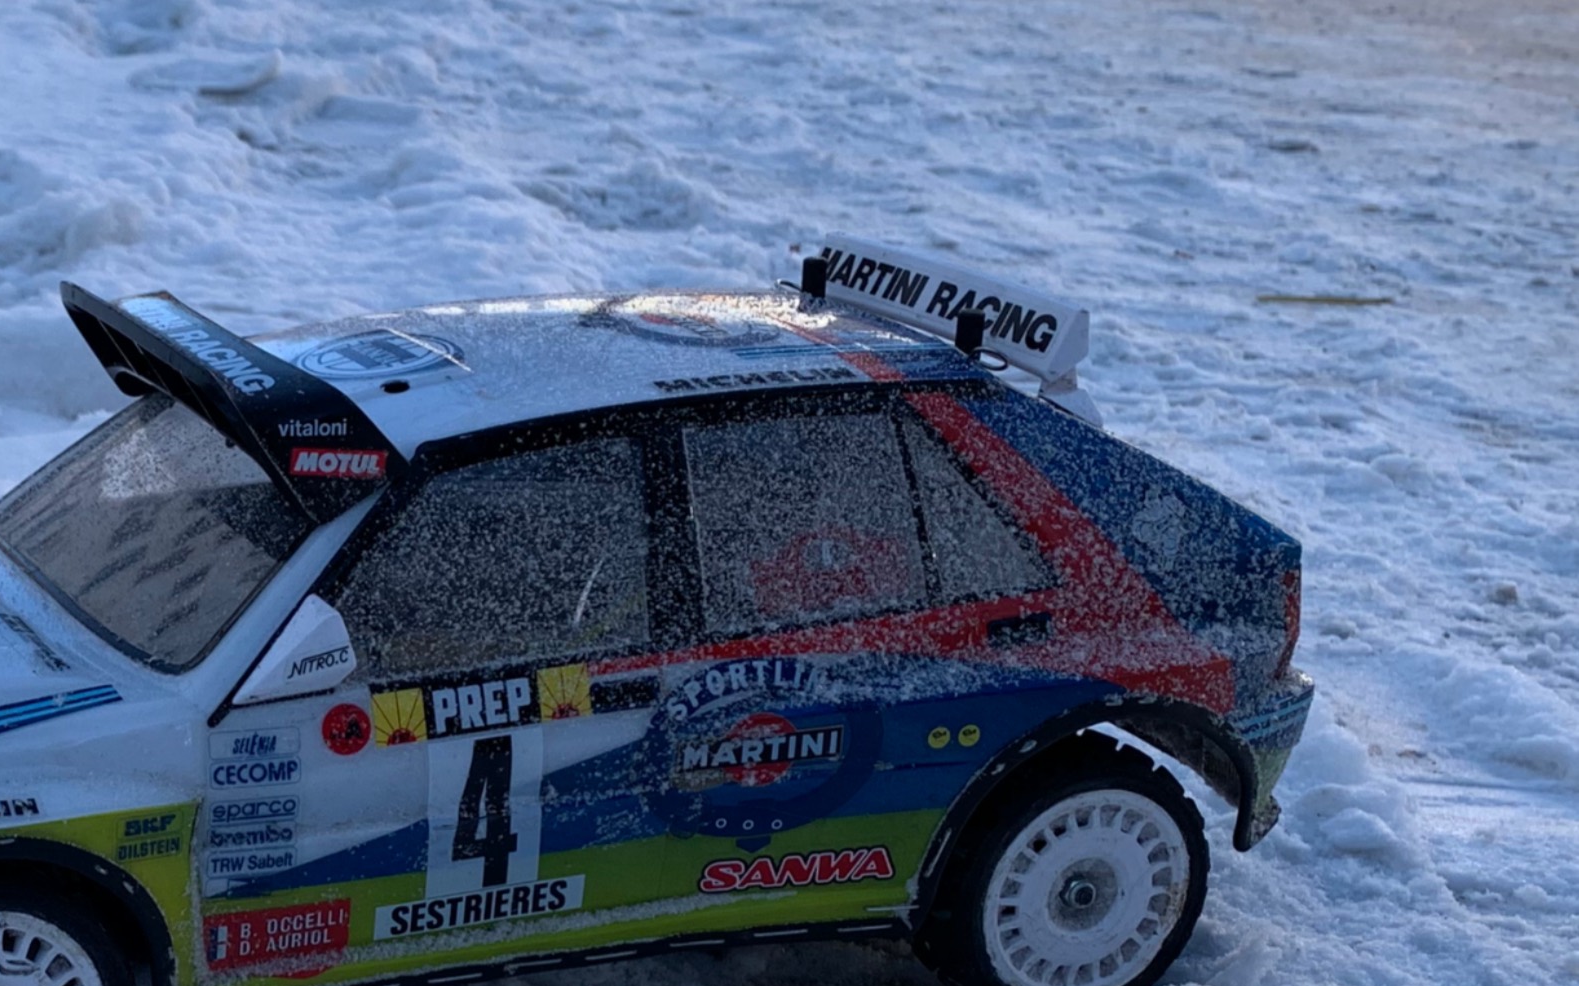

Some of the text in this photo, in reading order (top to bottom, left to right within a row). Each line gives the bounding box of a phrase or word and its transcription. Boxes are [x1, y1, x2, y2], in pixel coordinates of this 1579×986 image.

[821, 247, 1057, 352] MARTINI RACING
[178, 327, 276, 396] RACING
[654, 366, 858, 393] MICHELIN
[278, 418, 347, 437] vitaloni
[293, 450, 384, 475] MOTUL
[432, 677, 531, 734] PREP
[682, 728, 840, 771] MARTINI
[213, 759, 298, 786] CECOMP
[211, 798, 297, 823] sparco
[451, 735, 518, 888] 4
[210, 825, 294, 847] brembo
[211, 852, 294, 874] TRW Sabelt
[699, 847, 894, 893] SANWA
[389, 879, 568, 936] SESTRIERES
[267, 908, 345, 935] OCCELLI
[265, 928, 332, 953] AURIOL
